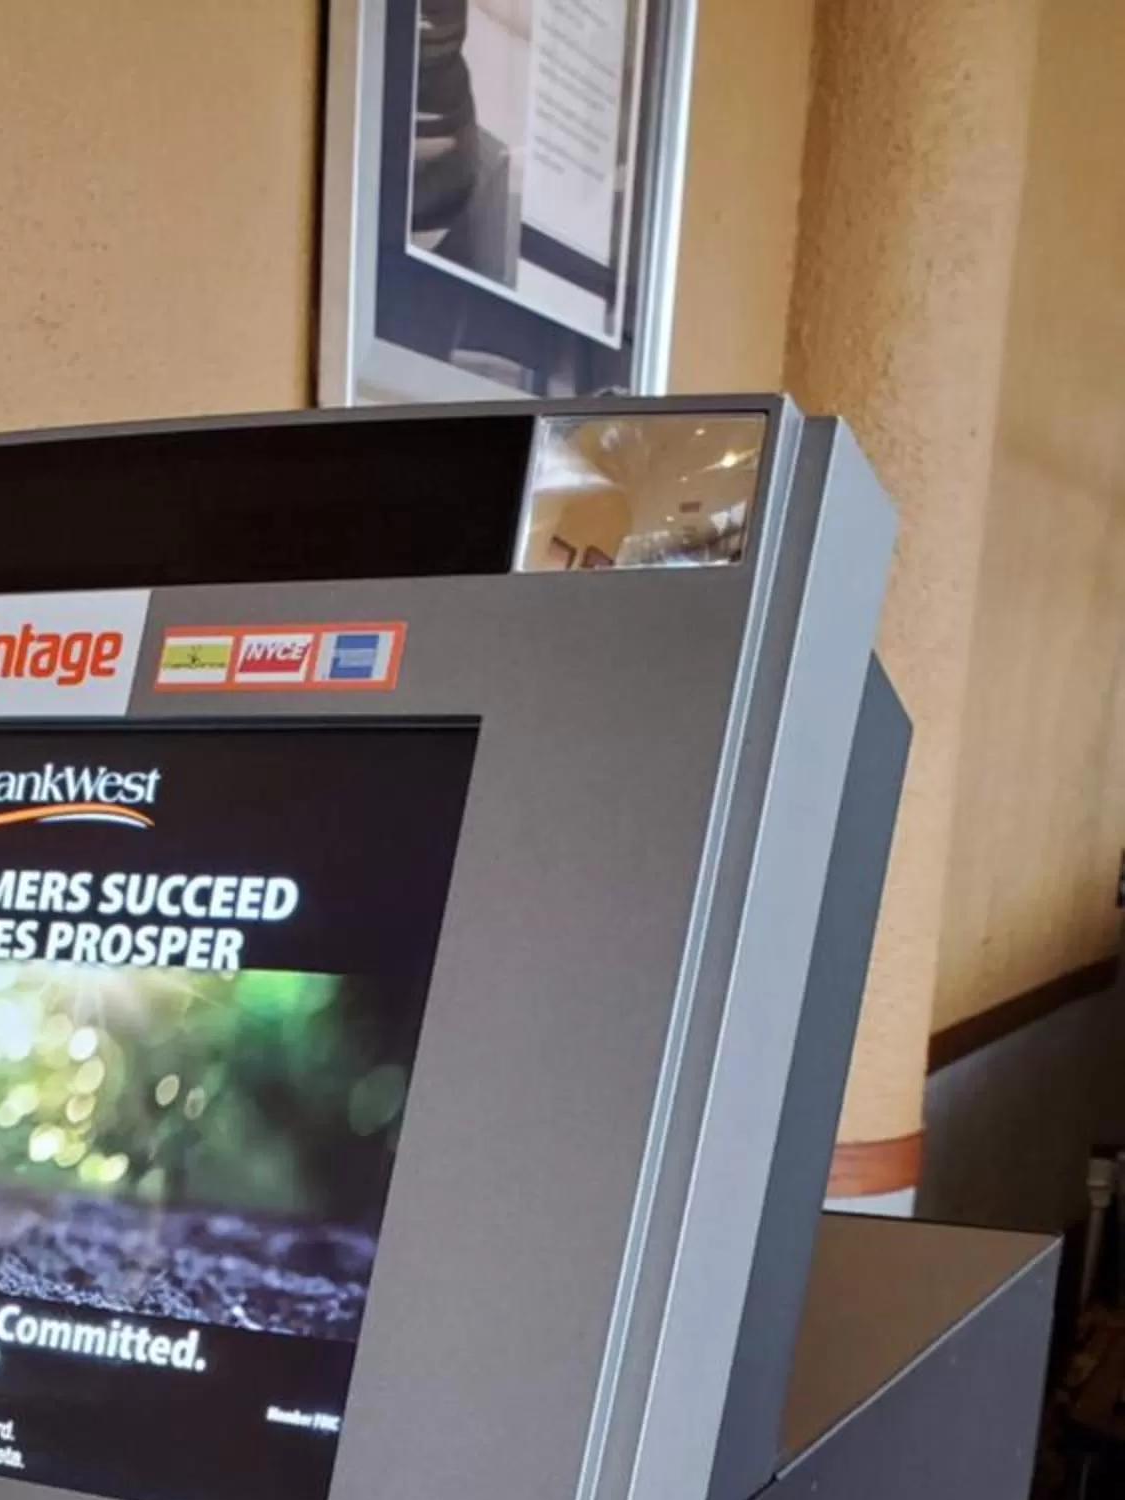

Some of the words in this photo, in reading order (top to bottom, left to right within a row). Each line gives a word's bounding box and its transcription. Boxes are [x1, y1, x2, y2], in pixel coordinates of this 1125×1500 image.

[246, 642, 306, 662] NYCE
[97, 872, 299, 921] SUCCEED
[44, 921, 245, 971] PROSPER
